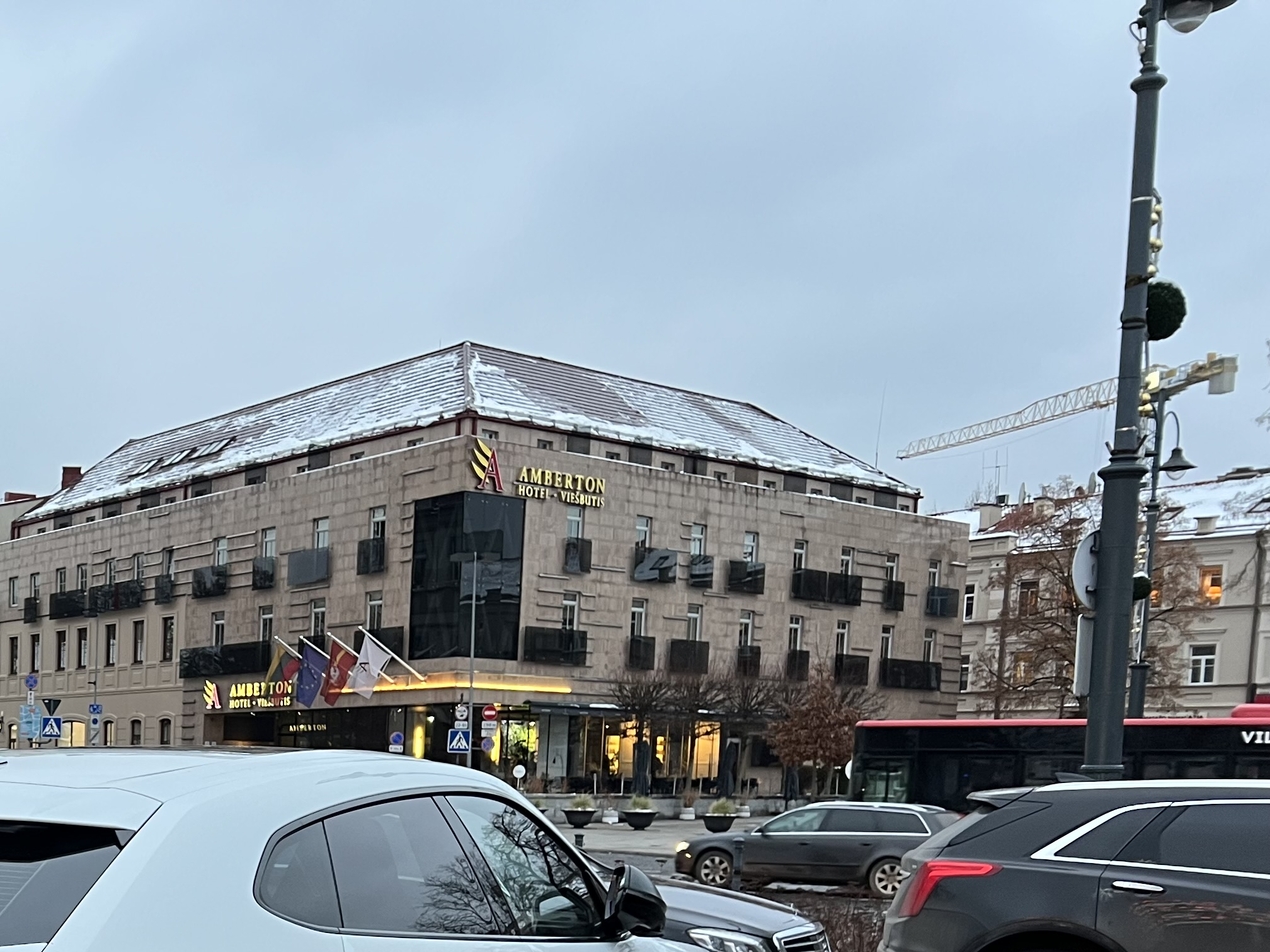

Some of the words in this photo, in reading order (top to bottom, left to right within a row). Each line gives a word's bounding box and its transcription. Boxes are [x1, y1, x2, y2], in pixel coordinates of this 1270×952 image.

[519, 465, 606, 494] AMBERTON
[518, 484, 551, 500] HOTEL
[560, 490, 605, 508] VIEŠBUTIS
[229, 680, 293, 698] AMBERTON
[229, 698, 252, 709] HOTEL
